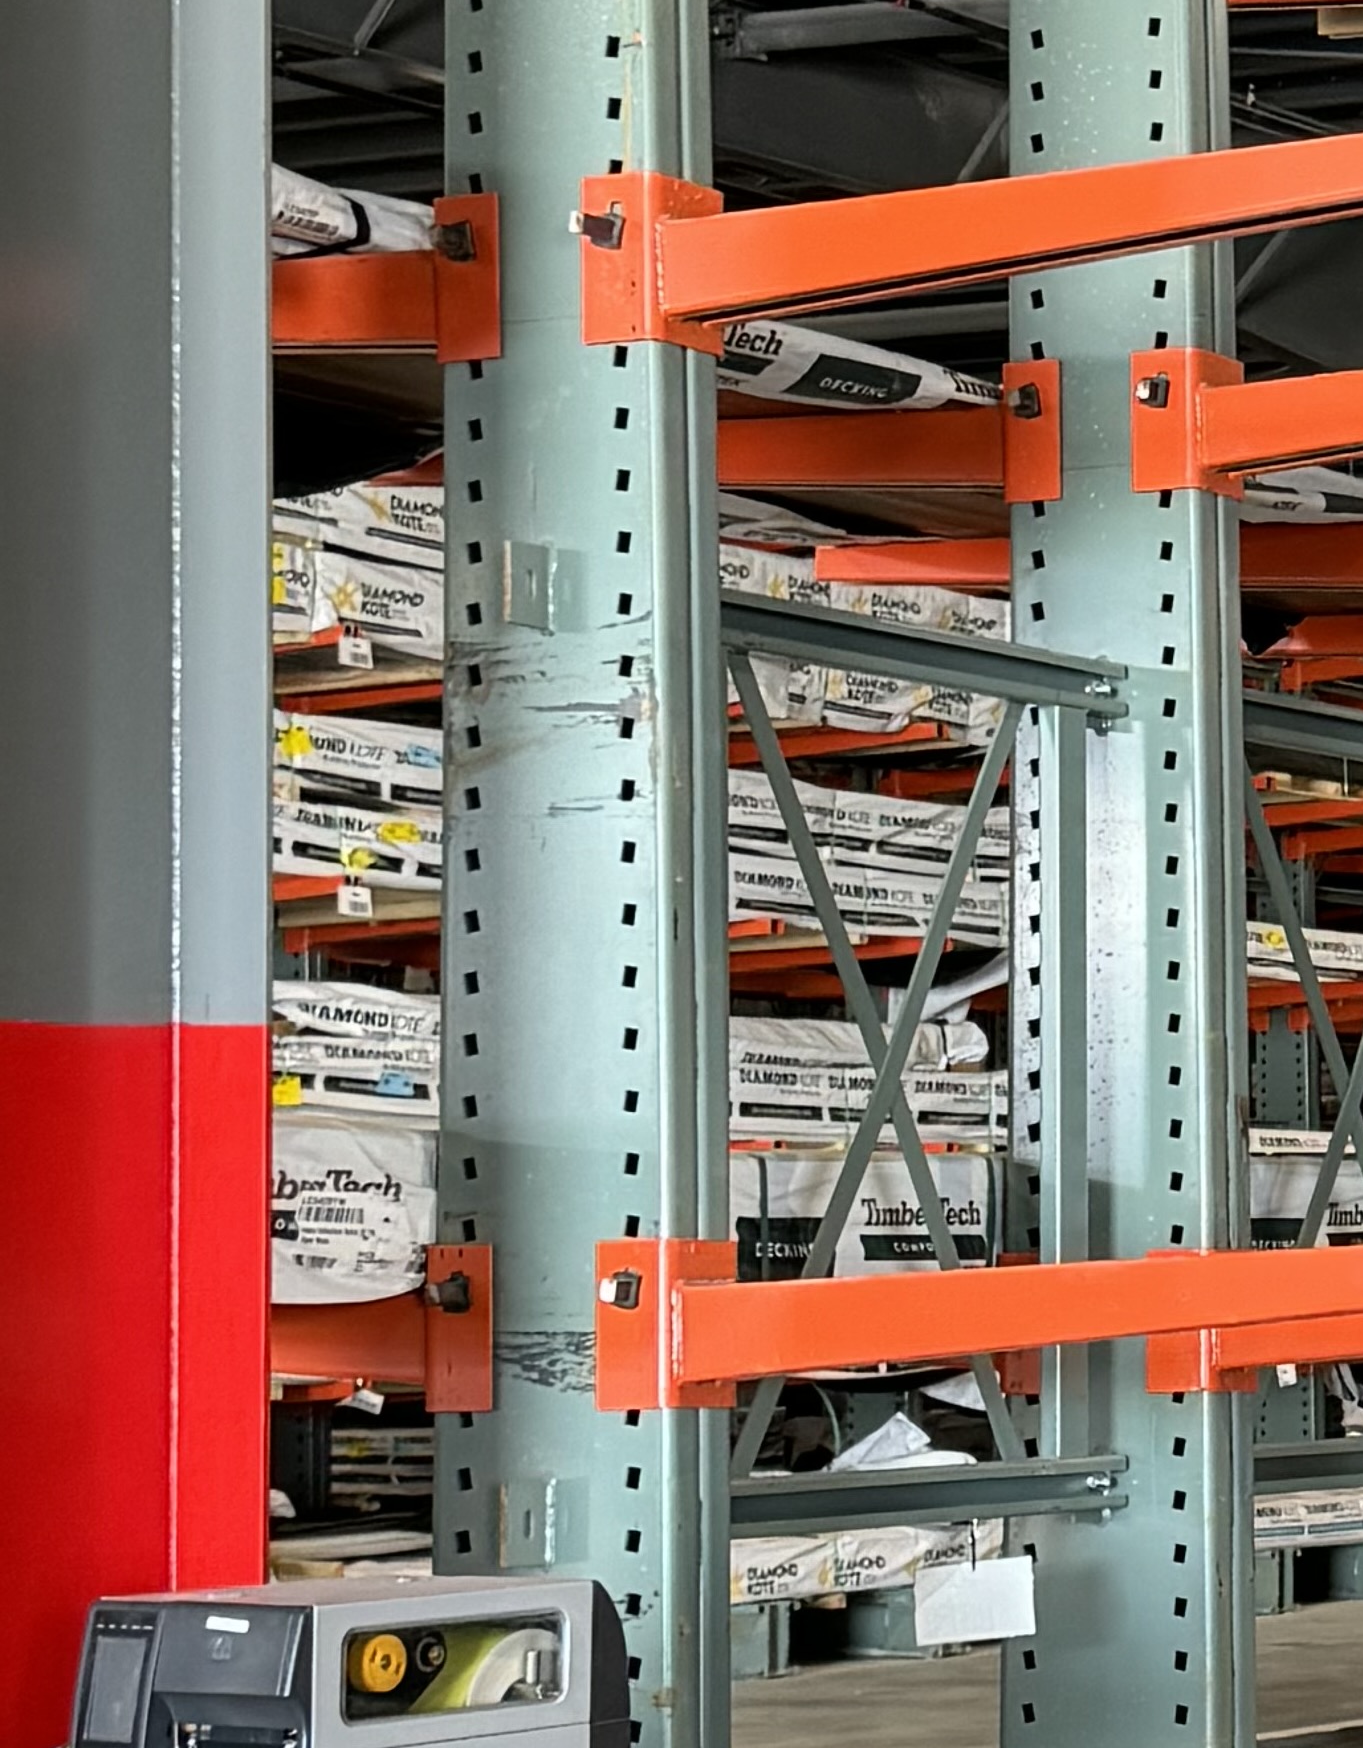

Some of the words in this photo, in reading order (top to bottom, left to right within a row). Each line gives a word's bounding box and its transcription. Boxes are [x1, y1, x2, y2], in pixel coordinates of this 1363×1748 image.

[818, 376, 889, 399] DECKING
[361, 581, 424, 607] DIAMOND
[361, 600, 393, 619] KOTE
[733, 870, 794, 889] DIAMOND
[740, 1068, 798, 1087] DIAMOND
[914, 1080, 967, 1096] DIAMOND
[861, 1197, 982, 1227] TimbeTech
